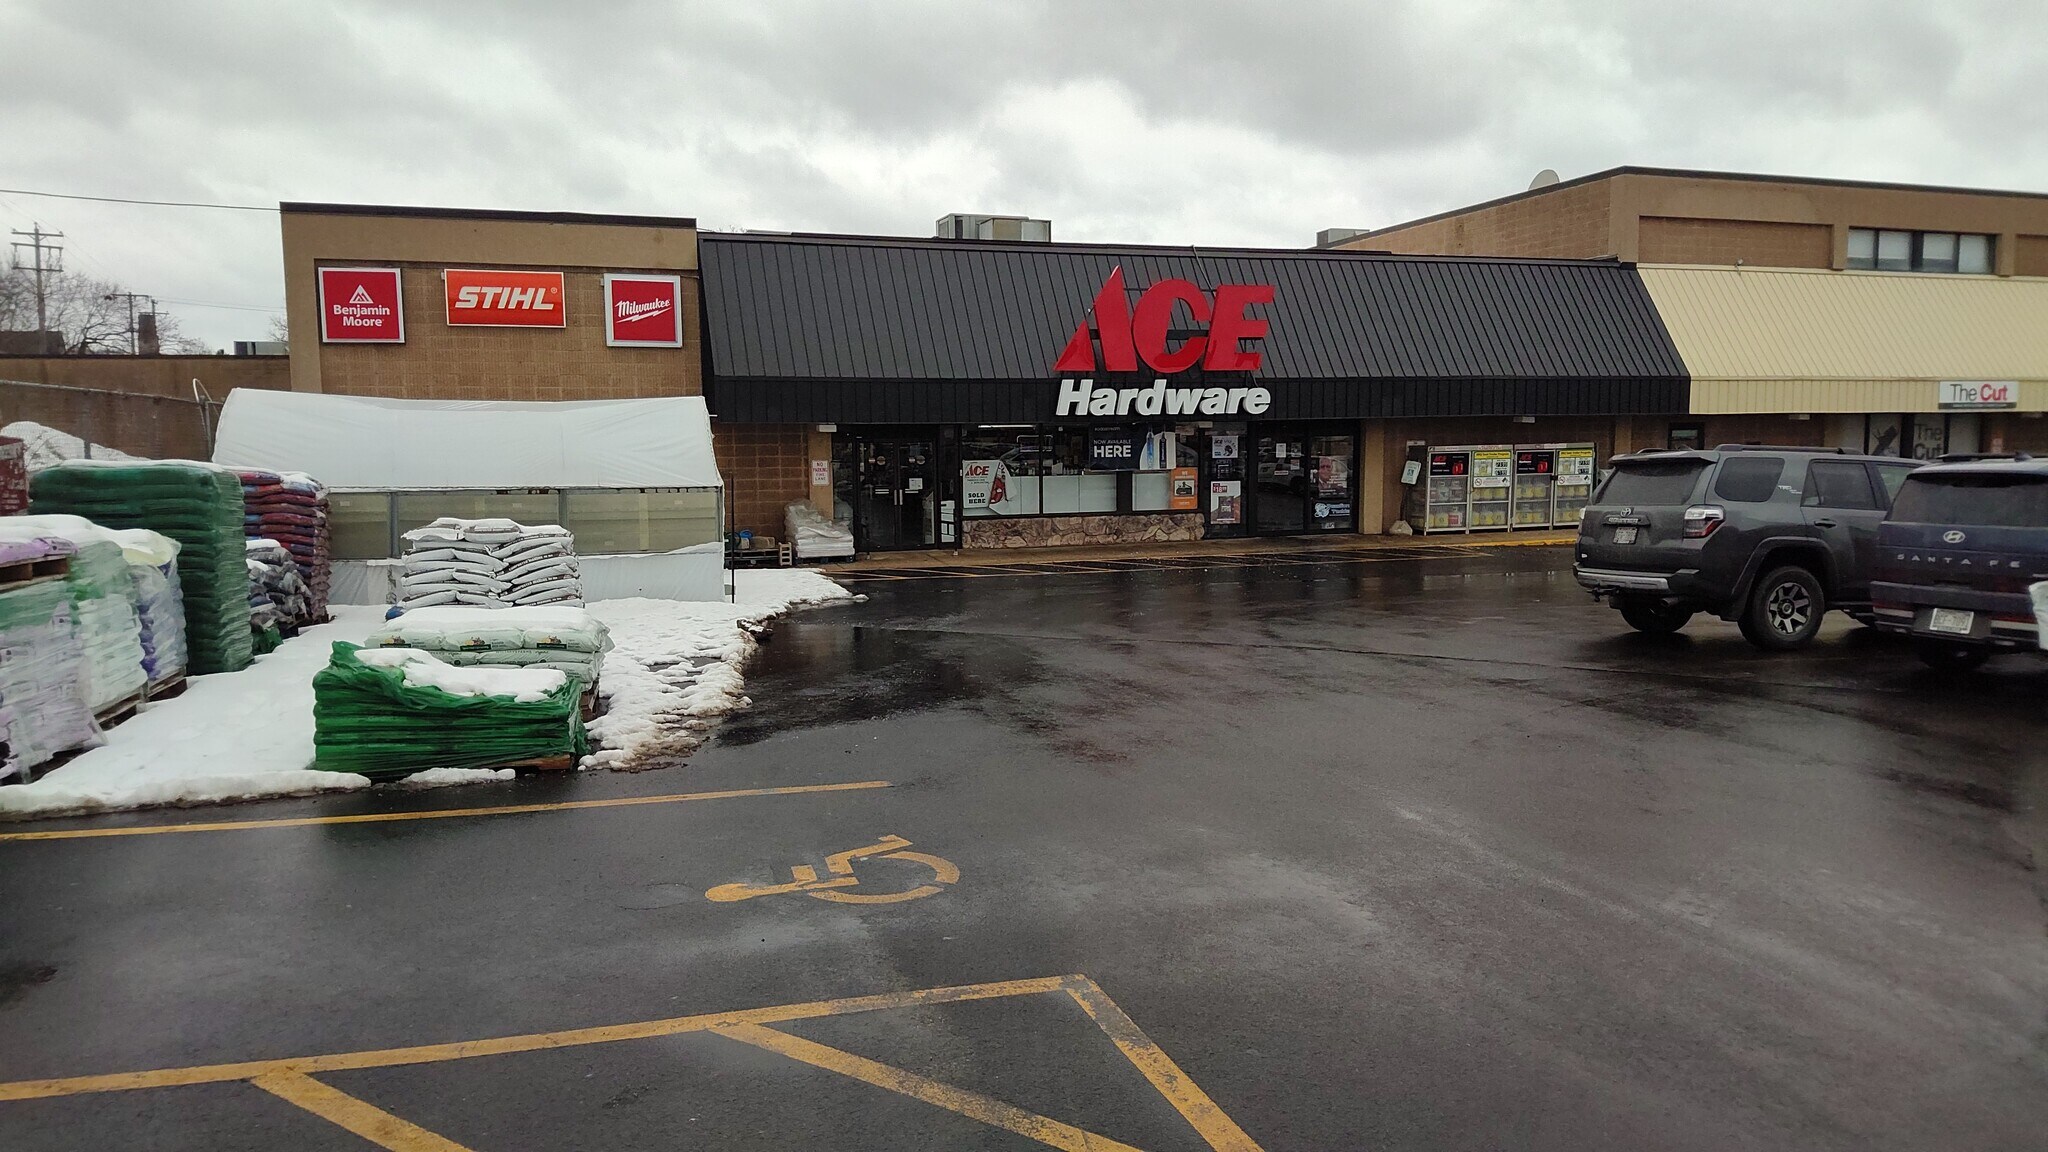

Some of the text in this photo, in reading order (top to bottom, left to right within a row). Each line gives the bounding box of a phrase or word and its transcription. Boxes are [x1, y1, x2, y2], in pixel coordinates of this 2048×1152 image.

[455, 285, 554, 310] STIHL
[333, 304, 391, 317] Benjamin
[614, 298, 671, 318] Milwaukee
[343, 316, 383, 327] Moore
[1053, 264, 1275, 373] ACE
[1055, 379, 1271, 416] Hardware
[1949, 383, 2008, 401] The Cut
[1093, 445, 1132, 458] HERE
[965, 464, 990, 476] ACE
[1897, 553, 2021, 568] SANTA FE
